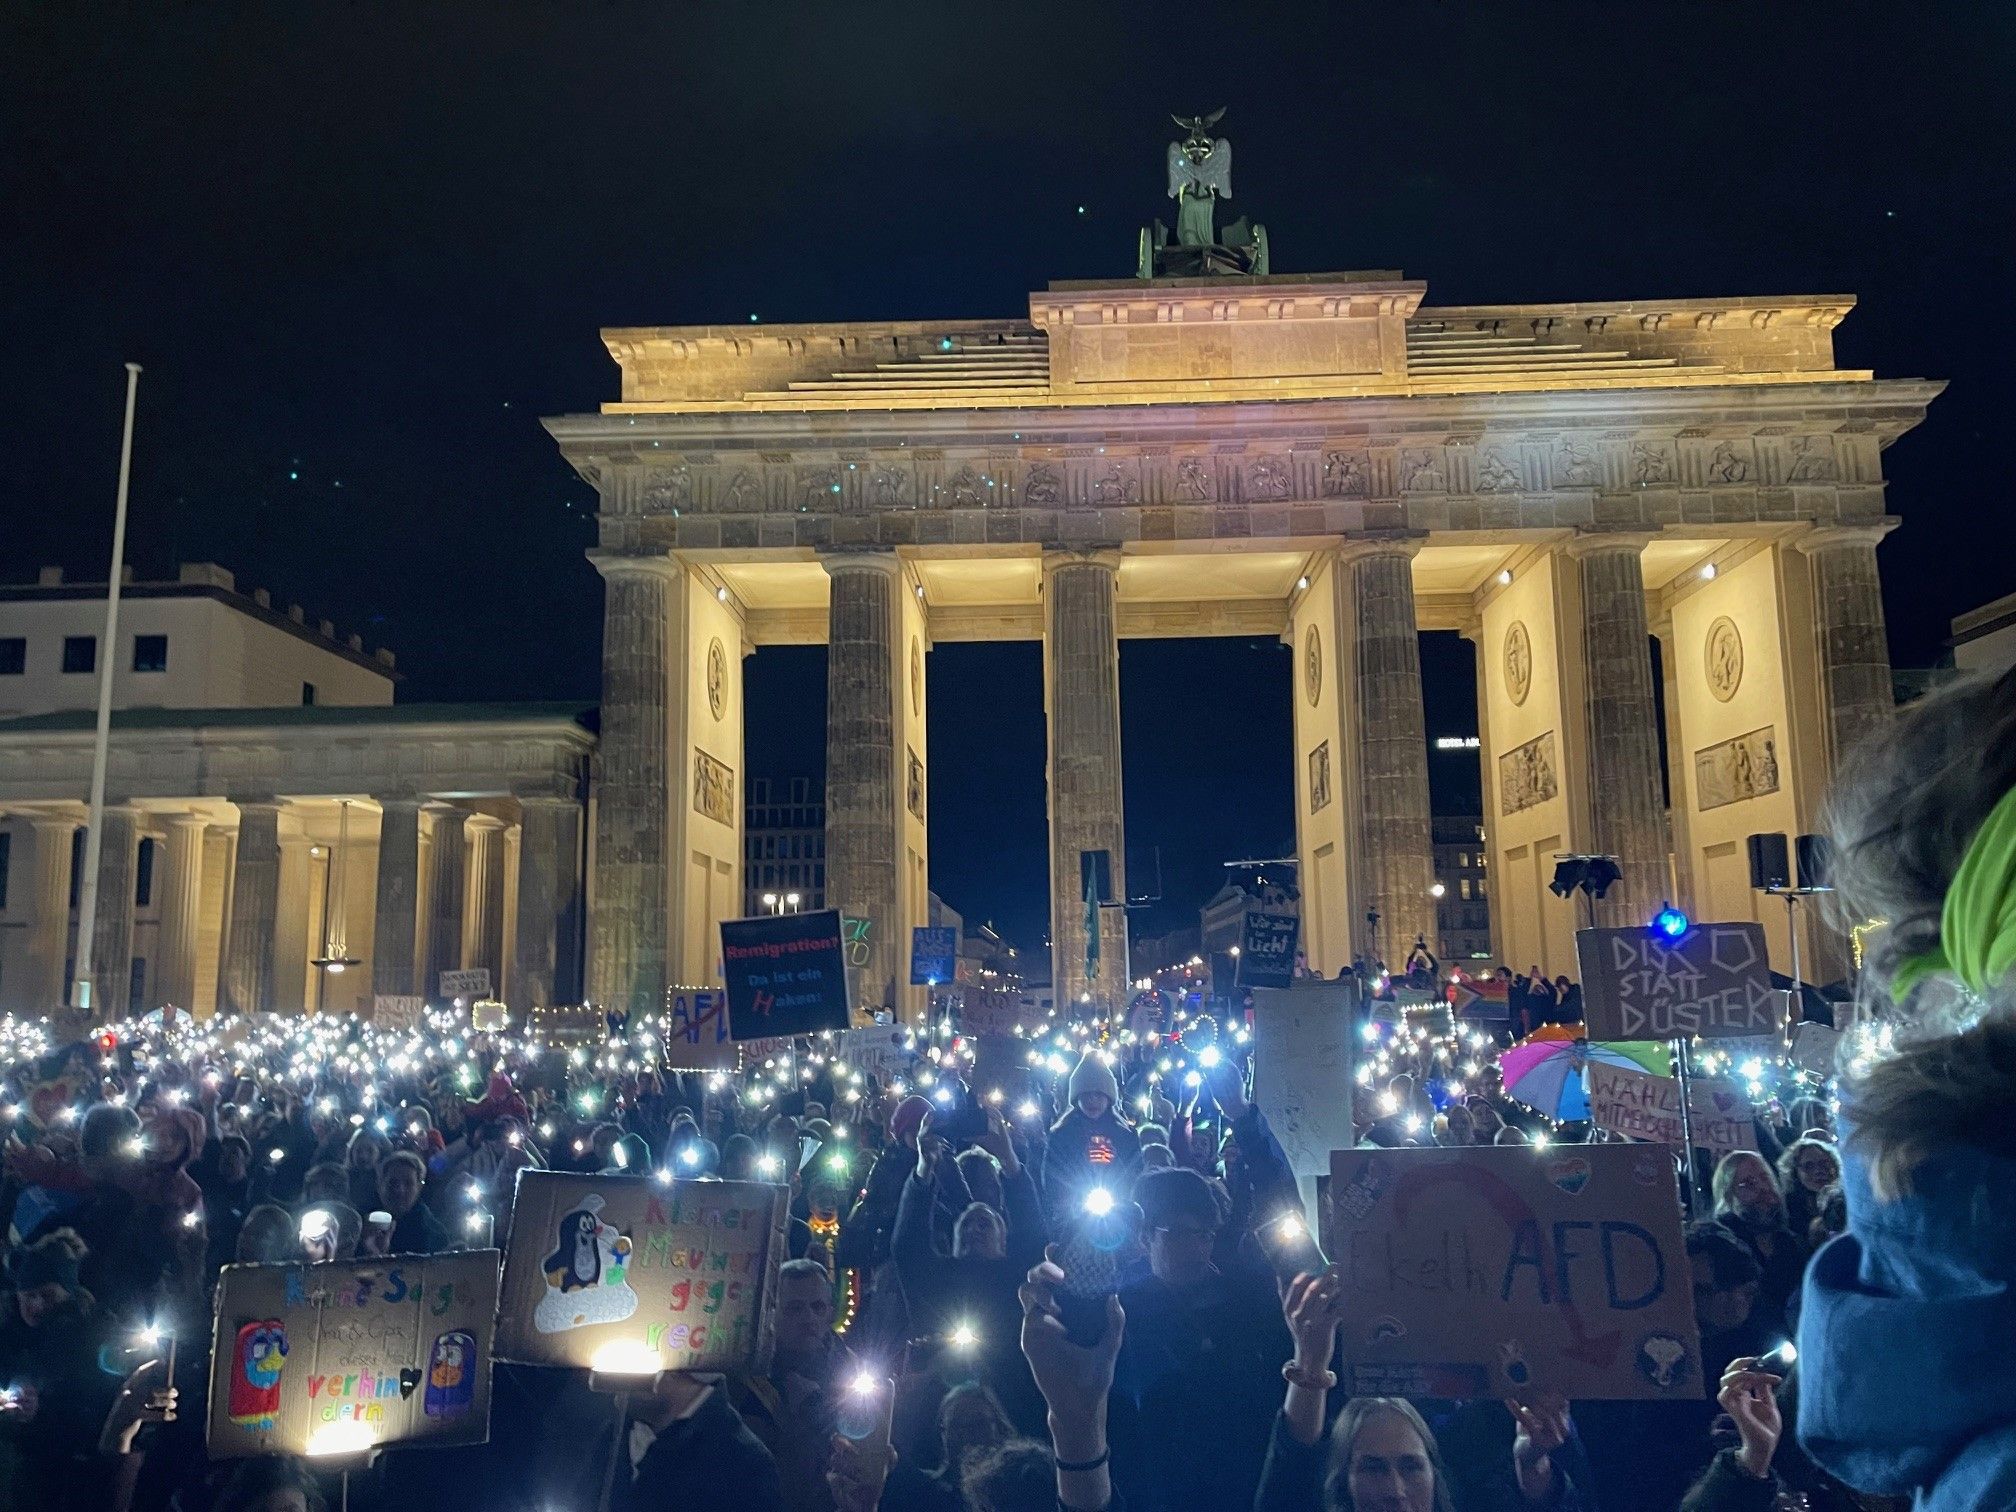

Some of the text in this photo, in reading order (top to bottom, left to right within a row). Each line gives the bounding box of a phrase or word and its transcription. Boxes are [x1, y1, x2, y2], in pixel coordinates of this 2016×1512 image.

[1248, 935, 1288, 954] Licht
[748, 974, 769, 987] Da
[797, 968, 822, 982] ein
[1619, 969, 1709, 1000] STATT
[1621, 976, 1775, 1036] DÜSTER
[1592, 1071, 1703, 1115] WÄHL
[307, 1366, 400, 1400] verhin
[321, 1400, 384, 1422] dern
